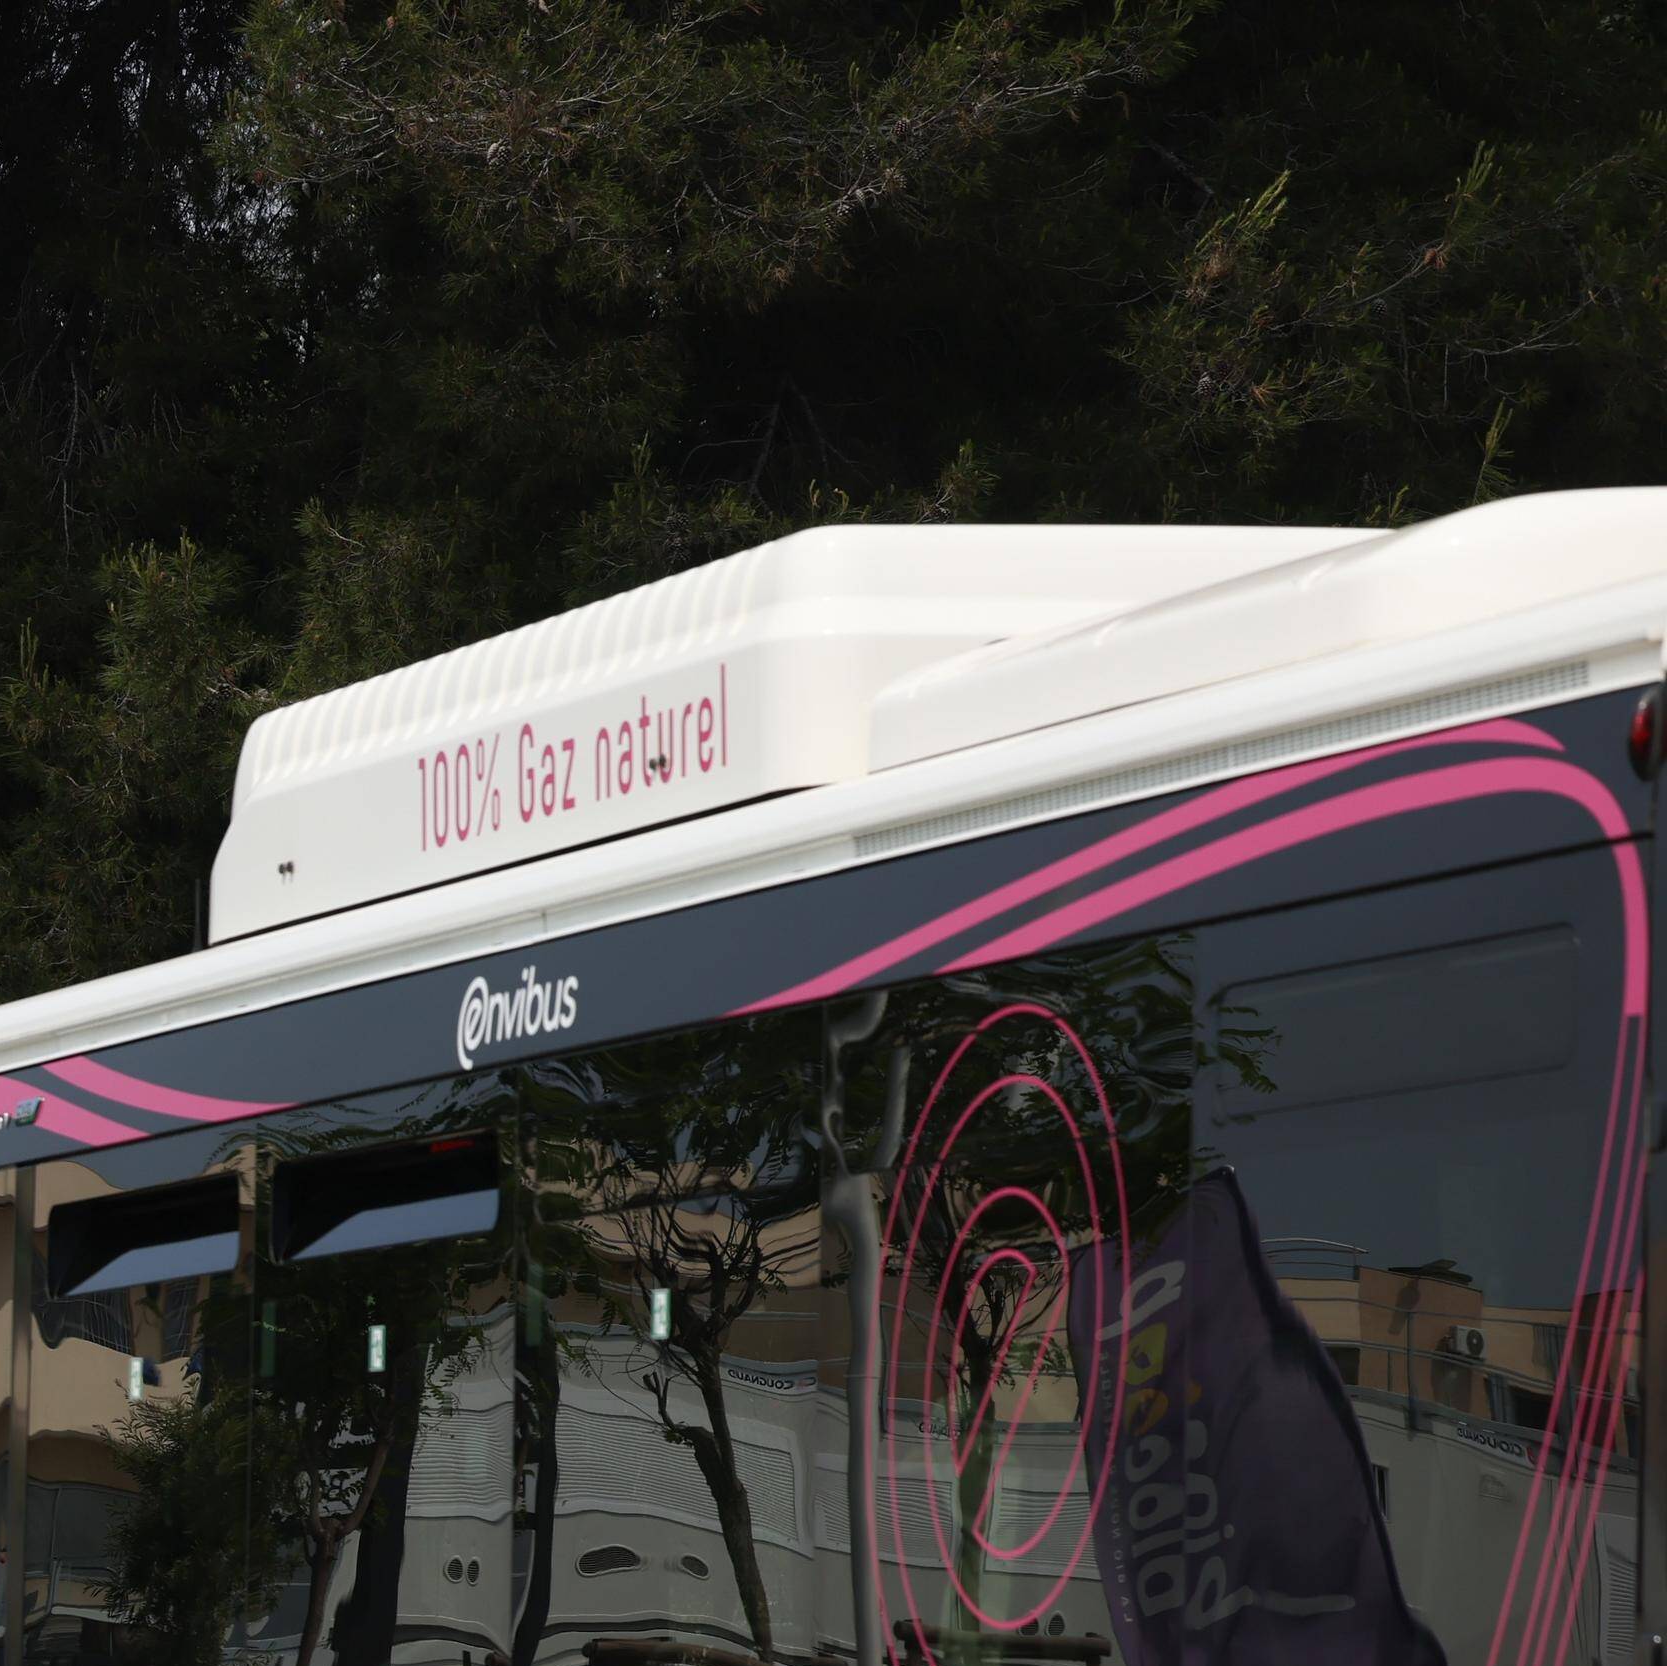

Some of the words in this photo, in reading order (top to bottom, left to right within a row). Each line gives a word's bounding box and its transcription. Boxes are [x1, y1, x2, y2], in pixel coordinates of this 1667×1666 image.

[418, 732, 500, 851] 100%
[519, 723, 575, 823] Gaz
[596, 663, 727, 801] naturel
